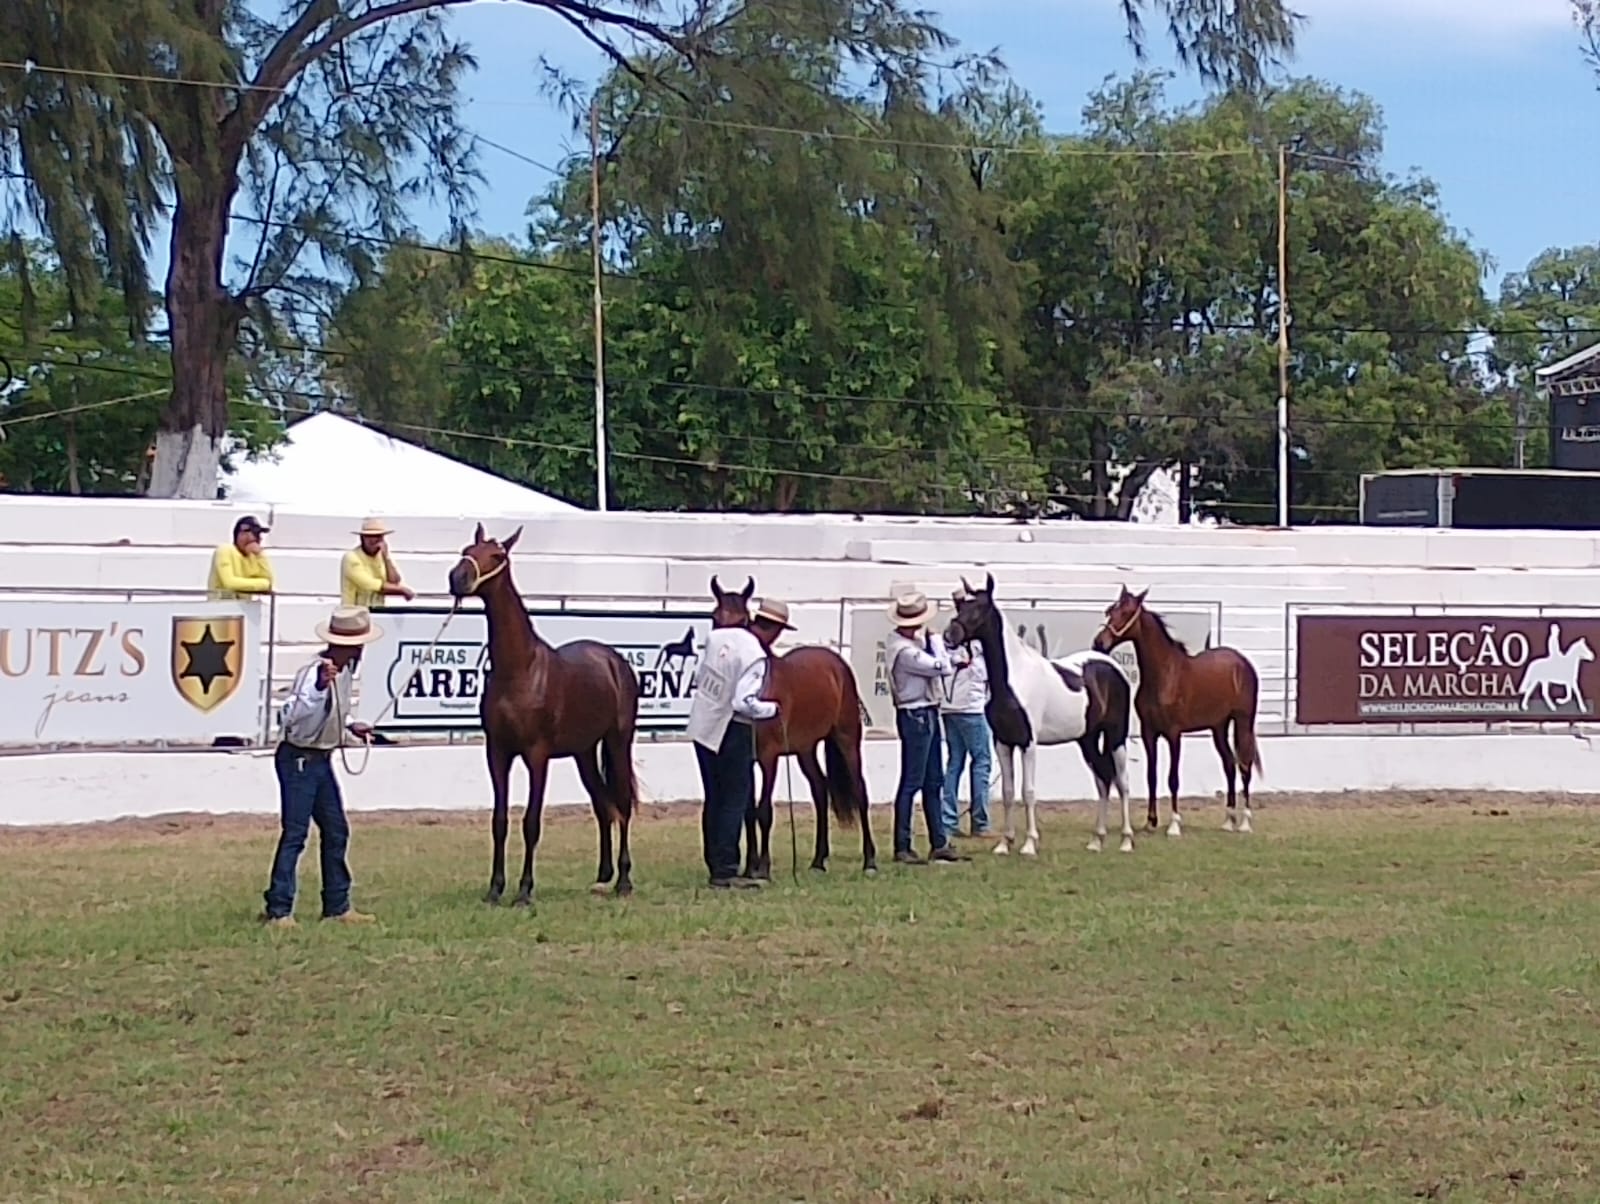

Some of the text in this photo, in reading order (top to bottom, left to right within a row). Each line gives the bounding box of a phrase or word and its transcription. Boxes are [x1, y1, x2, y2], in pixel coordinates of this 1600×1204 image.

[0, 621, 146, 677] UTZ'S
[411, 649, 467, 664] HARAS
[1360, 624, 1529, 674] SELEÇÃO
[402, 668, 479, 698] ARE
[703, 676, 720, 697] 116
[1358, 673, 1518, 697] DA MARCHA
[35, 684, 129, 739] jeans
